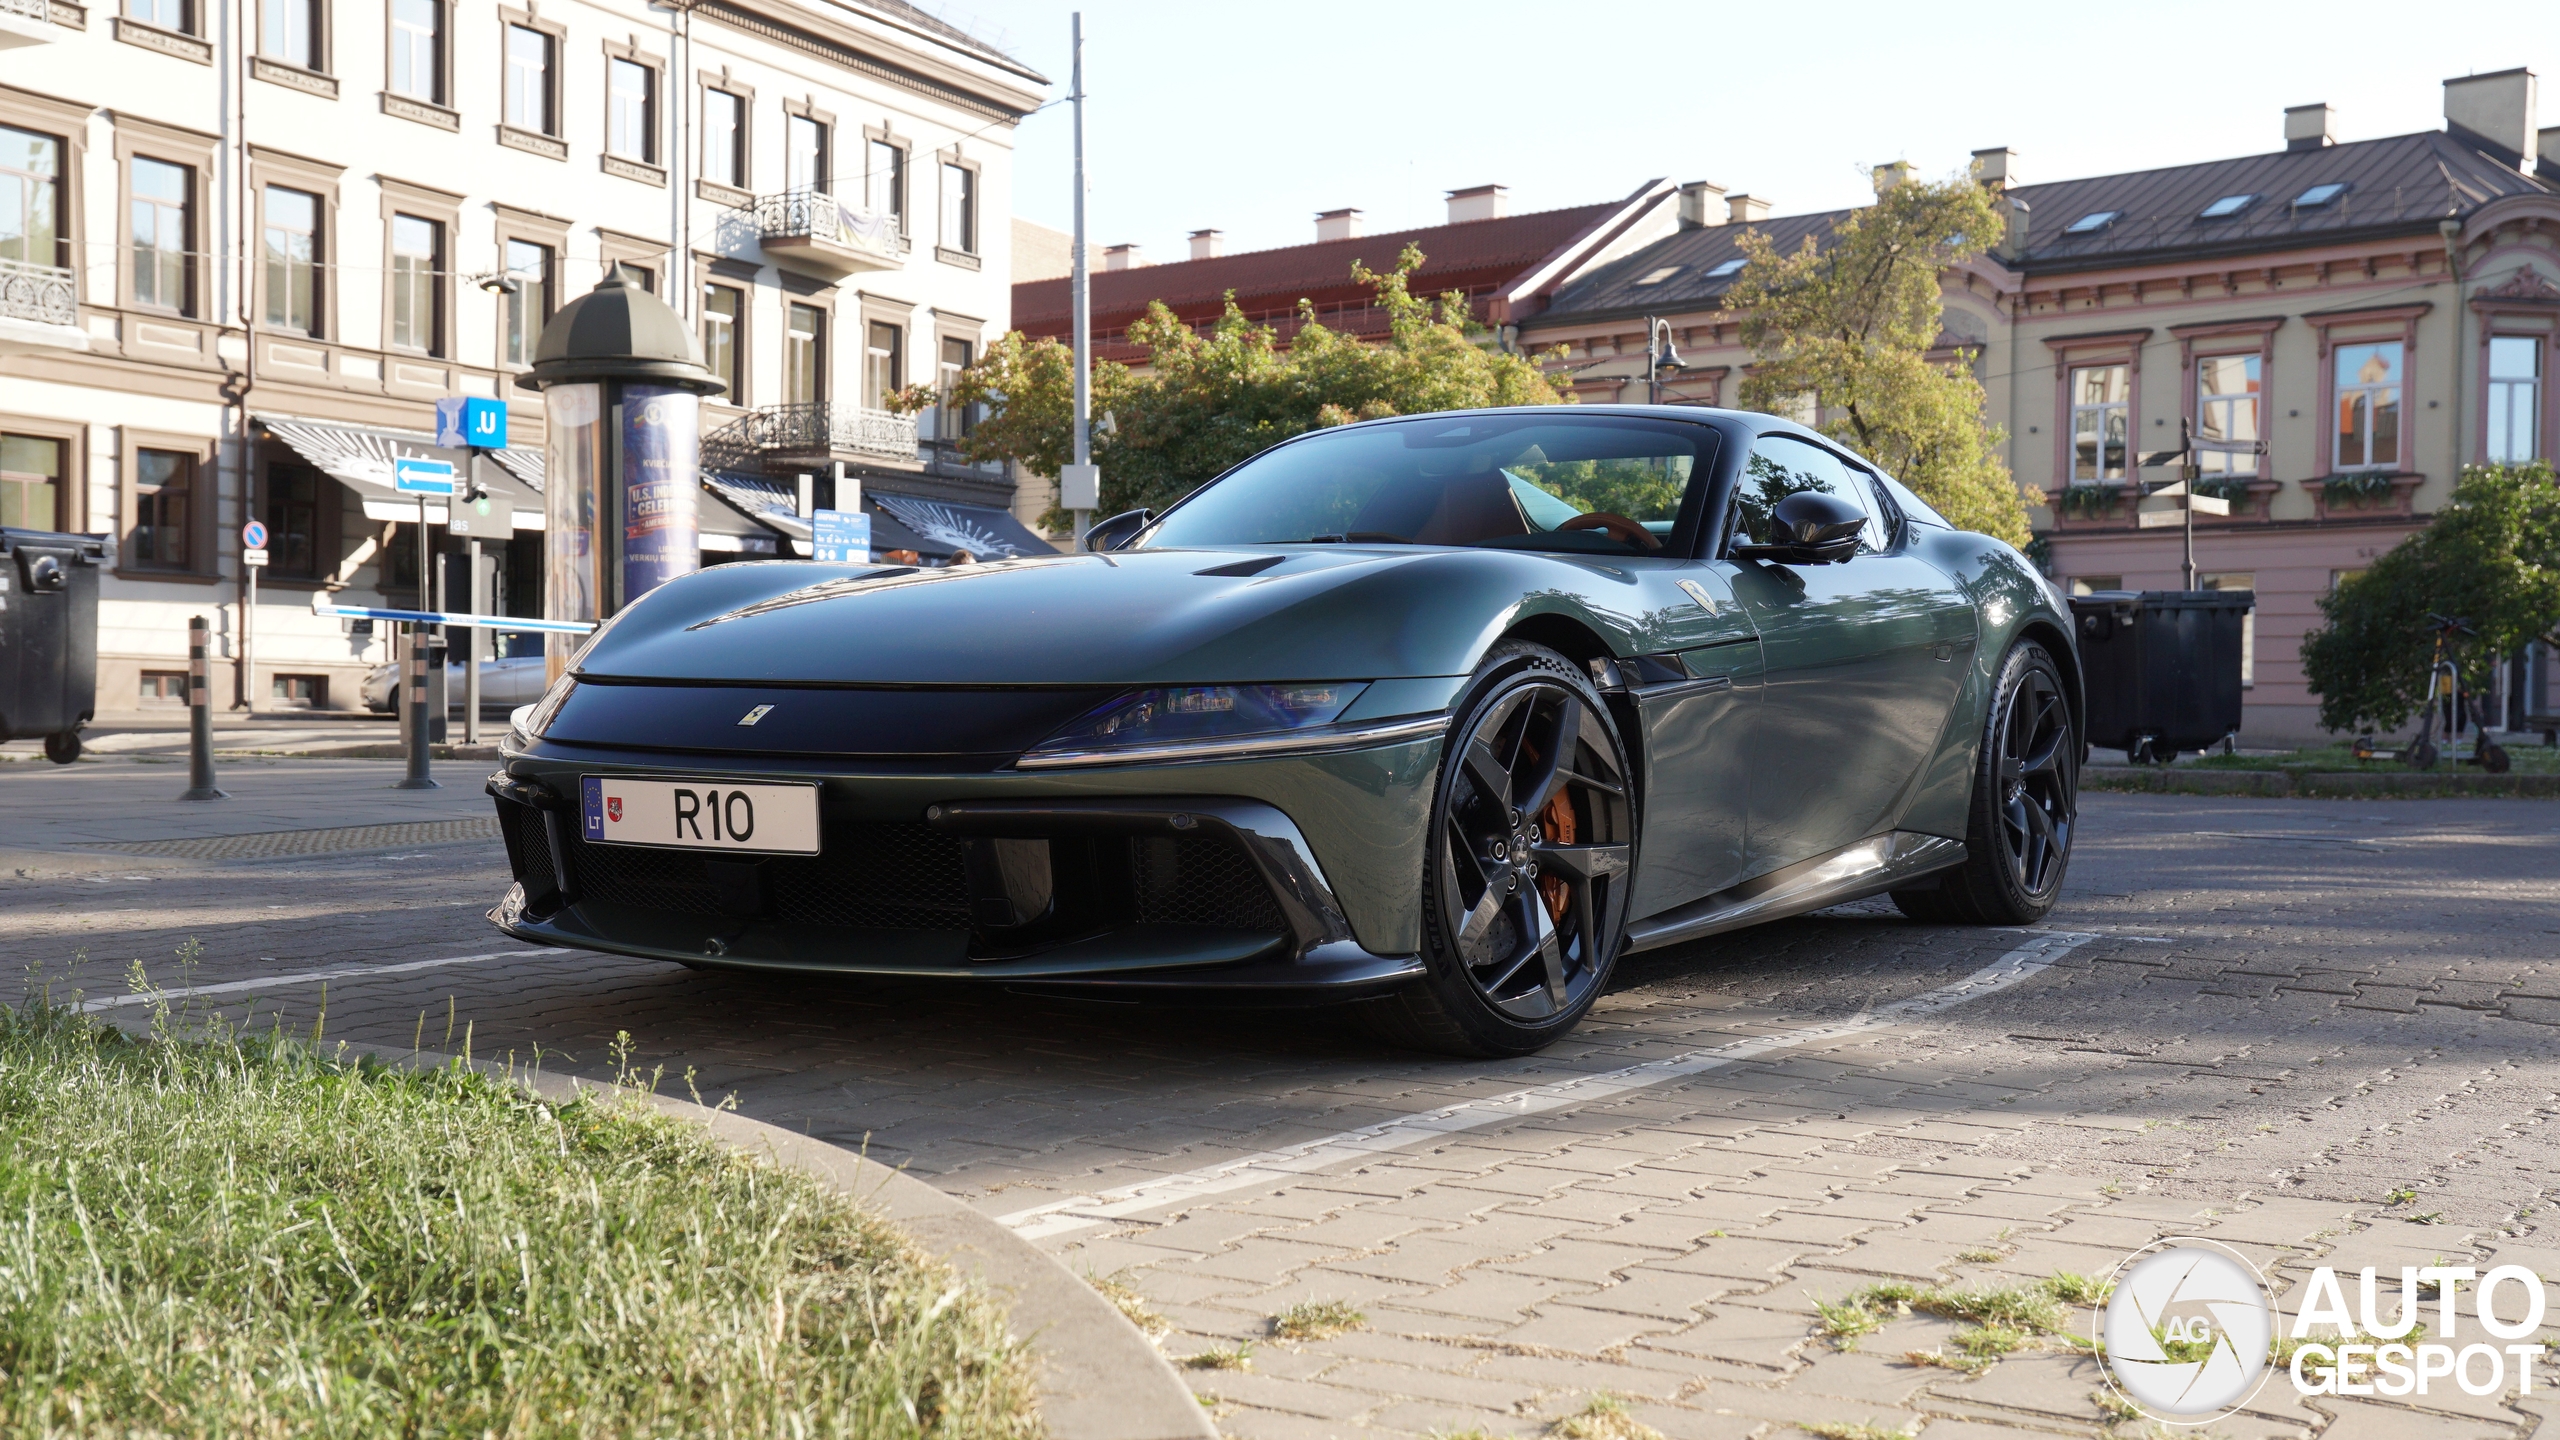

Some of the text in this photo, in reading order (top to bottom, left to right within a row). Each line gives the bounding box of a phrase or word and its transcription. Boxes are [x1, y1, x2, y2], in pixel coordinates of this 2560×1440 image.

[632, 487, 652, 502] U.S.
[588, 815, 602, 831] LT
[674, 788, 754, 843] R10
[1422, 846, 1444, 950] MICHELIN
